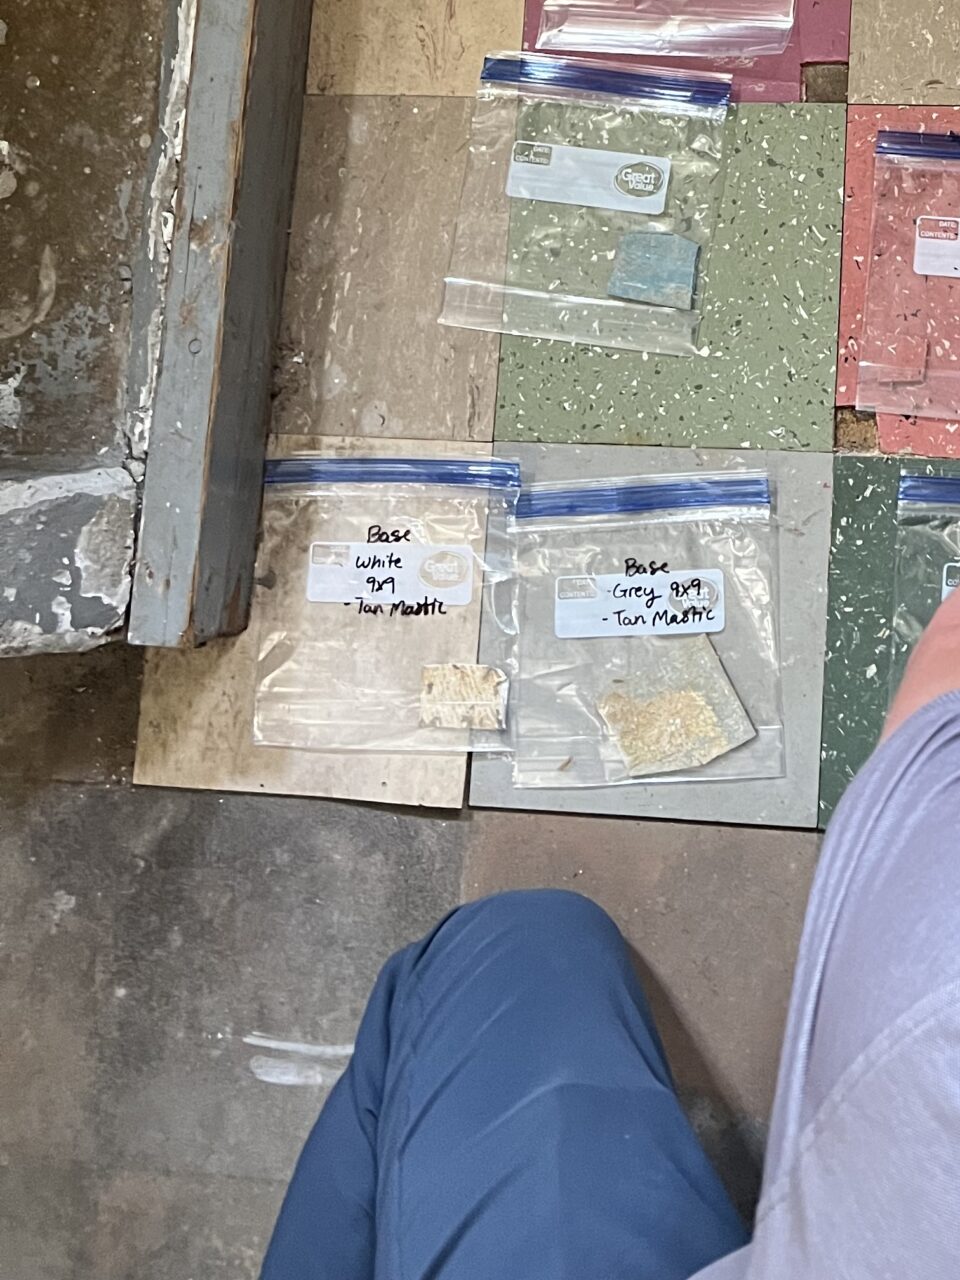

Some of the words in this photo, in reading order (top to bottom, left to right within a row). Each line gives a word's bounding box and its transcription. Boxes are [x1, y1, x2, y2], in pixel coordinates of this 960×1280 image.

[621, 168, 655, 183] Great
[628, 180, 654, 191] Value
[366, 524, 411, 544] Base
[624, 557, 670, 577] Base
[366, 576, 395, 594] 9x9
[670, 578, 702, 597] 9x9
